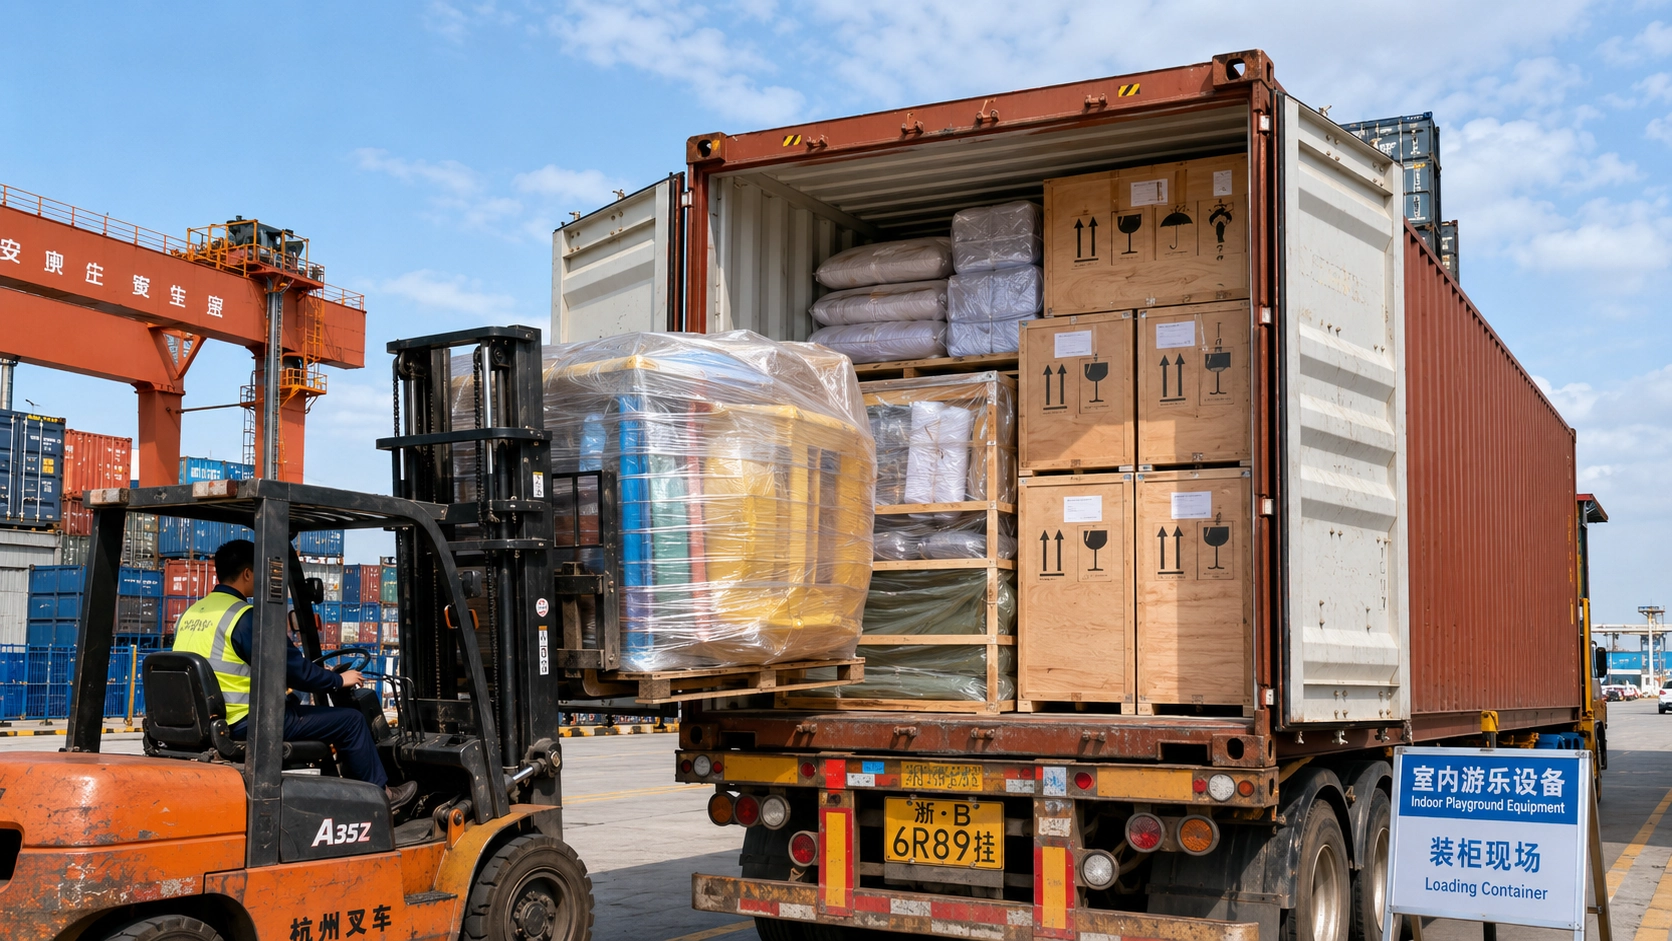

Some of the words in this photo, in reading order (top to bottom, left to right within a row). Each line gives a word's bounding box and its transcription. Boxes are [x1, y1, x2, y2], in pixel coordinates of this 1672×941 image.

[1412, 765, 1565, 797] 室内游乐设备
[1411, 795, 1443, 808] Indoor
[1446, 797, 1504, 812] Playground
[1507, 800, 1565, 815] Equipment
[310, 818, 372, 848] A35Z
[893, 826, 996, 863] 6R89挂
[1429, 836, 1541, 873] 装柜现场
[1425, 877, 1478, 897] Loading
[1481, 881, 1549, 900] Container
[289, 904, 392, 941] 杭州叉车
